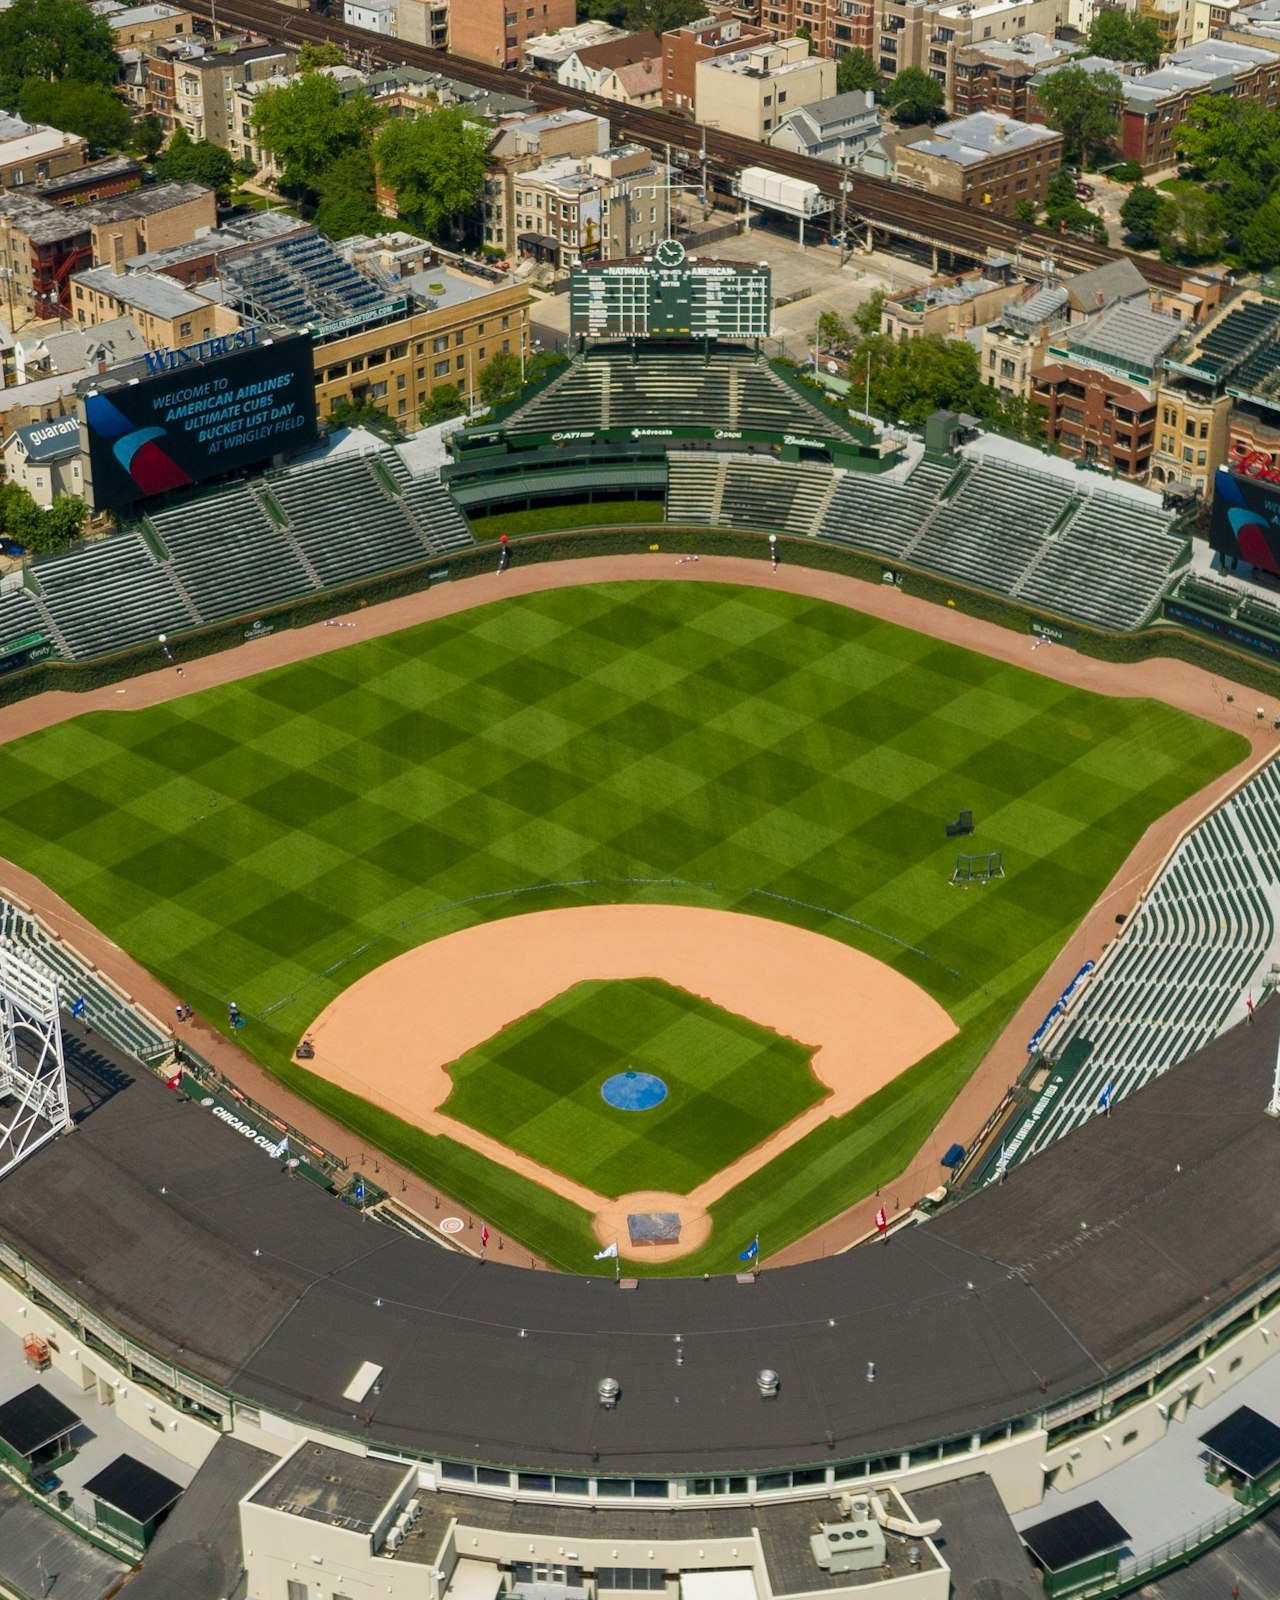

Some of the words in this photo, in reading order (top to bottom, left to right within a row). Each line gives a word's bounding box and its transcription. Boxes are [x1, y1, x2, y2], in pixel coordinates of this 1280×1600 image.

[608, 267, 650, 276] NATIONAL
[691, 267, 733, 276] AMERICAN
[319, 305, 393, 334] WRIGLEYROOFTOPS.COM
[144, 325, 261, 375] WINTRUST
[153, 384, 211, 410] WELCOME
[213, 378, 228, 390] TO
[166, 394, 233, 422] AMERICAN
[236, 373, 294, 400] AIRLINES'
[185, 406, 241, 431] ULTIMATE
[243, 395, 273, 412] CUBS
[198, 421, 243, 442] BUCKET
[246, 414, 268, 428] LIST
[270, 403, 295, 420] DAY
[208, 441, 223, 455] AT
[225, 428, 274, 449] WRIGLEY
[275, 415, 304, 434] FIELD
[641, 429, 673, 437] Advocate
[1045, 1084, 1058, 1098] FIELD
[212, 1106, 257, 1138] CHICAGO
[254, 1135, 284, 1158] CUBS
